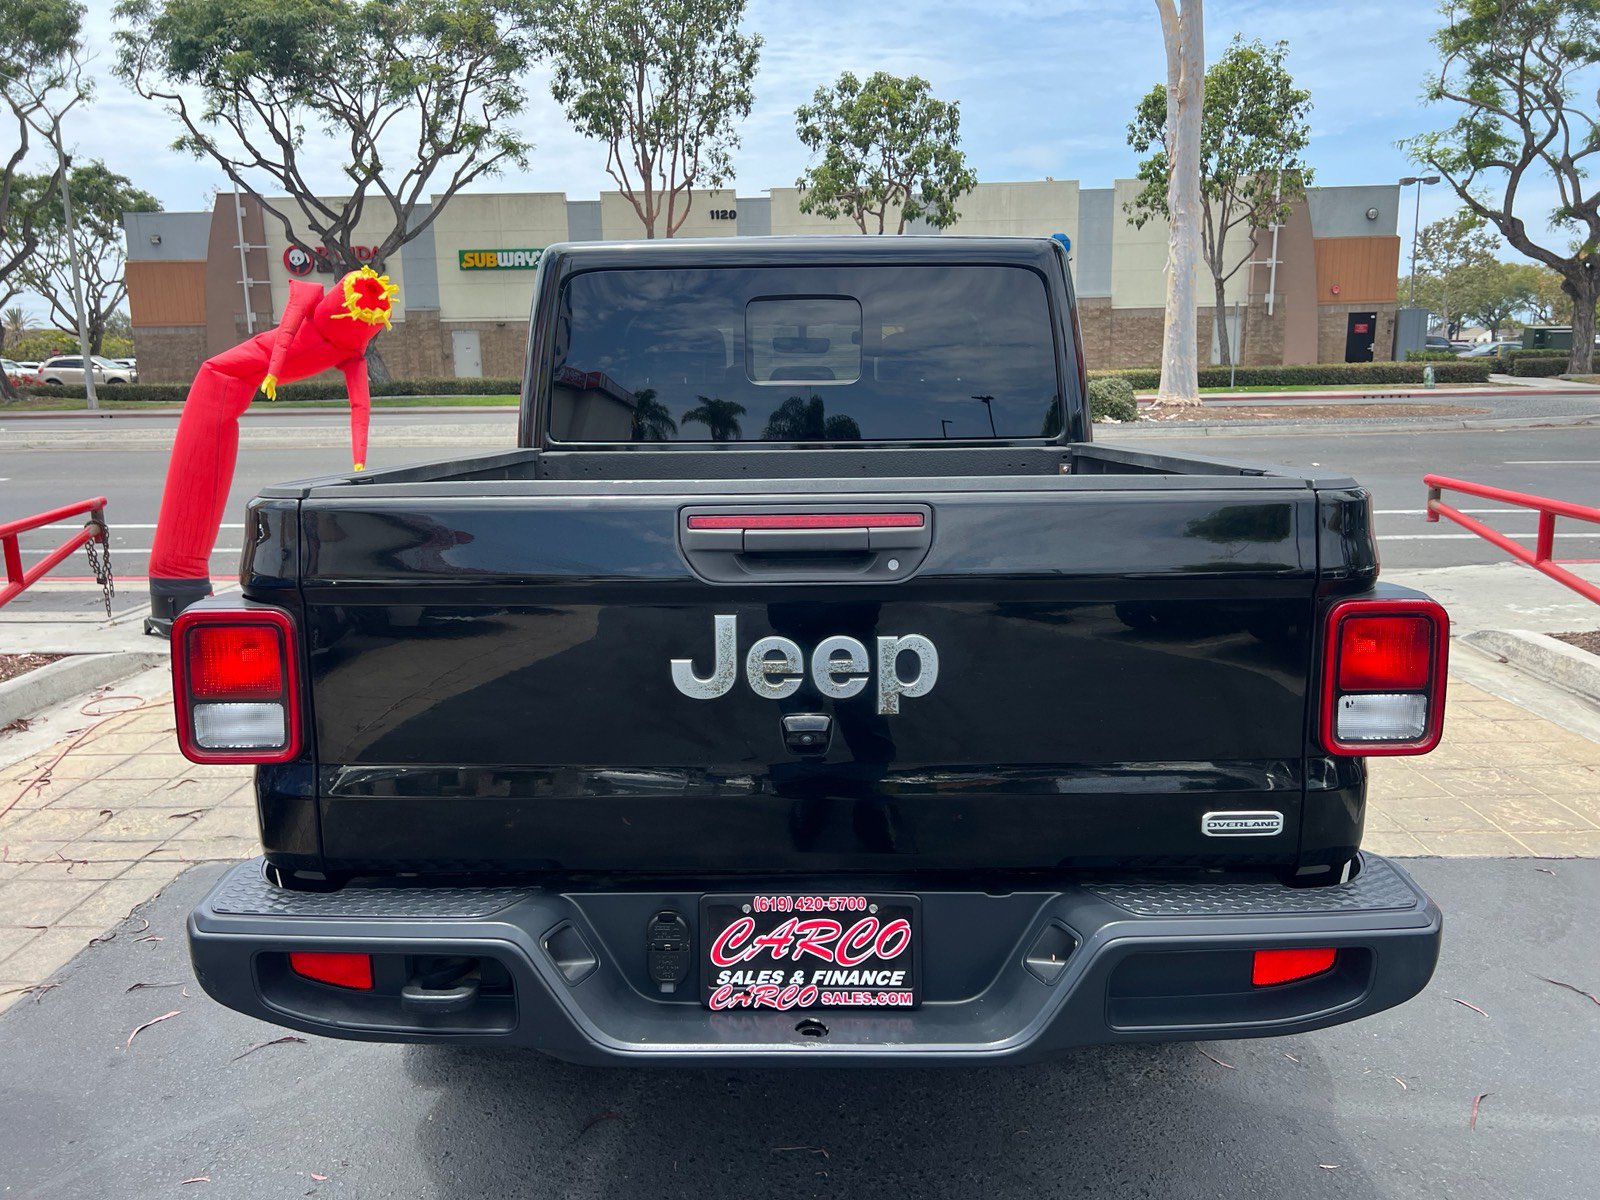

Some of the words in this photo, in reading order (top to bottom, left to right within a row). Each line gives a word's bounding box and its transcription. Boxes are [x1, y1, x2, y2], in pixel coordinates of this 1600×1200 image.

[709, 209, 737, 220] 1120
[461, 250, 541, 268] SUBWAY
[670, 614, 939, 714] Jeep
[753, 896, 792, 912] (619)
[795, 896, 867, 912] 420-5700
[710, 916, 912, 967] CARCO
[716, 970, 784, 986] SALES
[789, 970, 805, 986] &
[811, 970, 905, 986] FINANCE
